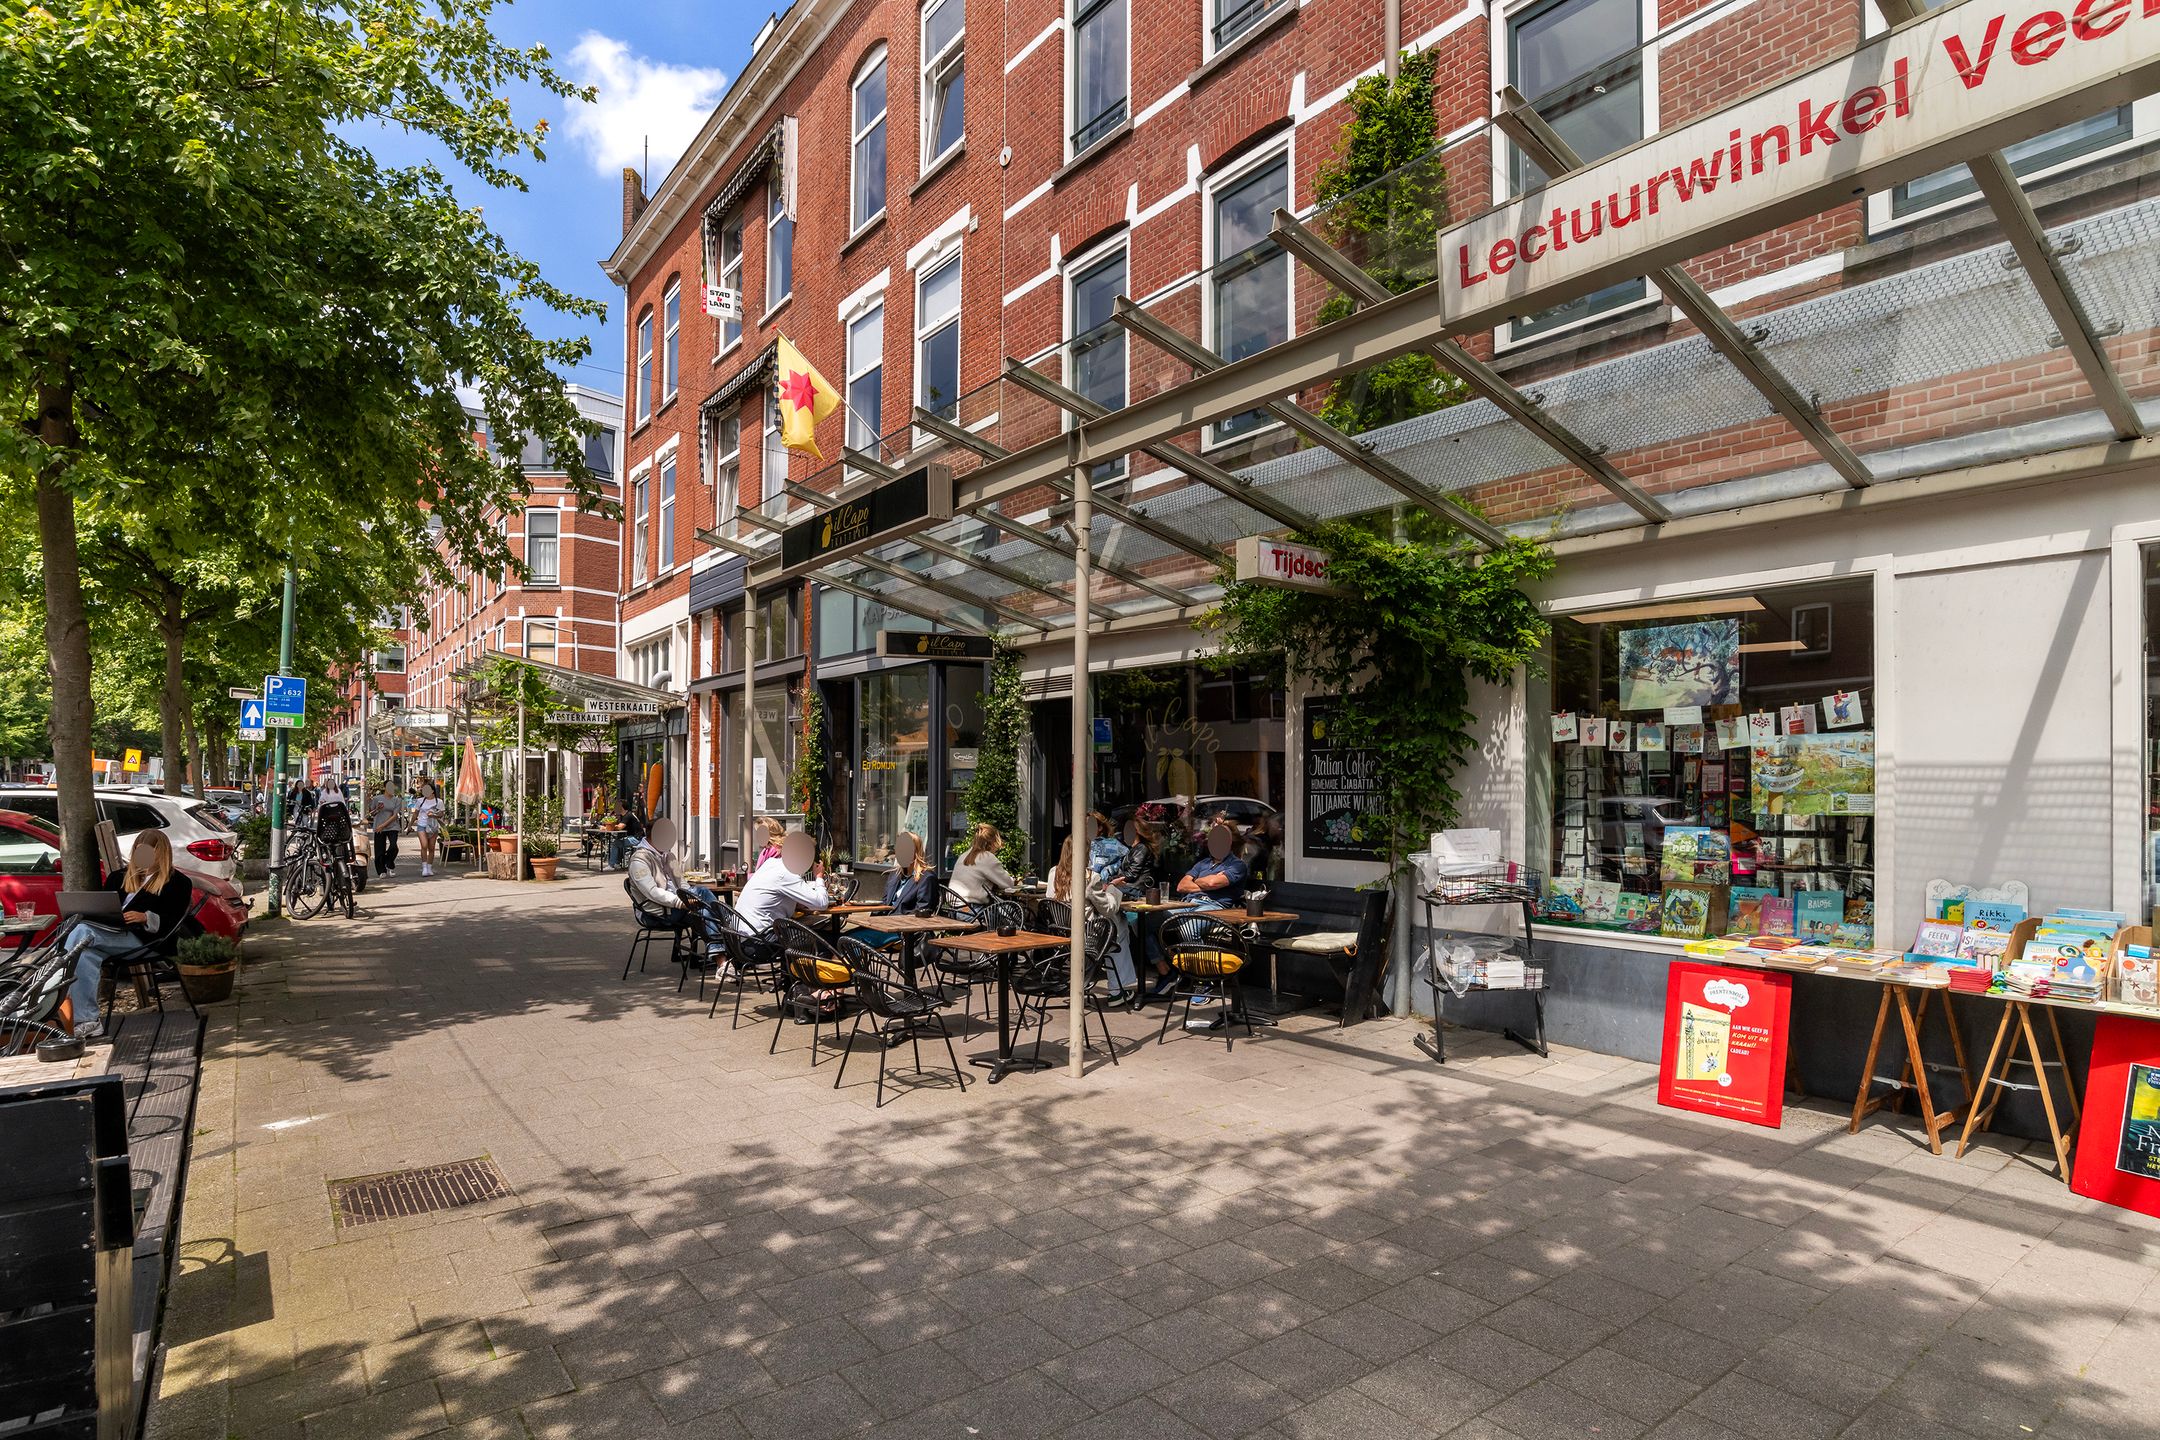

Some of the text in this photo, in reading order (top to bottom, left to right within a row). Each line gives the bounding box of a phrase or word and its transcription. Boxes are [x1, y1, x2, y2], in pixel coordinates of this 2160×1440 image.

[1459, 0, 2160, 290] Lectuurwinkel Vee
[710, 290, 730, 298] STAD
[843, 505, 869, 529] Capo
[940, 636, 966, 652] Capo
[269, 678, 283, 694] P
[590, 701, 657, 712] WESTERKAATJE
[549, 713, 609, 722] WESTERKAATJE
[1163, 696, 1221, 753] Capo
[1309, 751, 1376, 778] Italian Coffee
[1311, 778, 1338, 790] HOMEMADE
[1310, 794, 1352, 821] ITALIAANSE
[1979, 909, 2006, 918] Rikki
